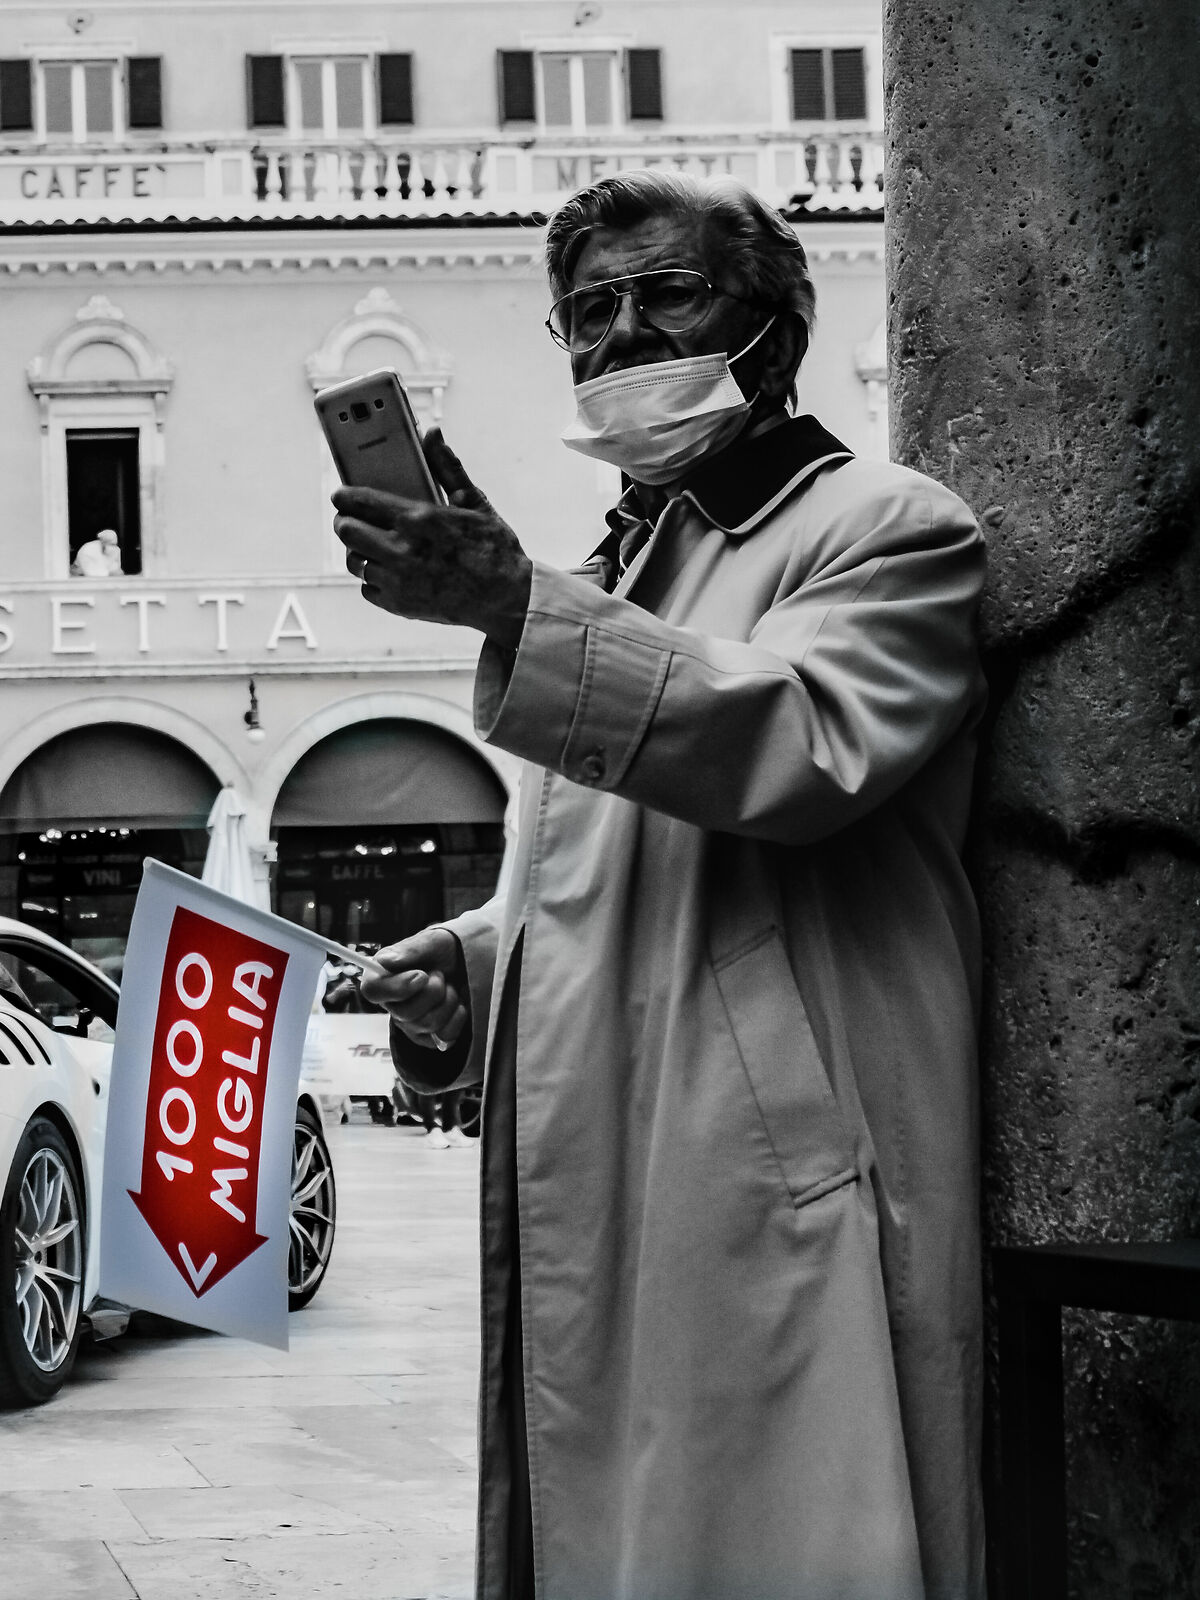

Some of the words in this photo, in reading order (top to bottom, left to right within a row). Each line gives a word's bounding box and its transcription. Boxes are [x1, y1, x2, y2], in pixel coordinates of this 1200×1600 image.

[82, 868, 122, 887] VINI
[155, 951, 214, 1181] 1000
[210, 960, 274, 1224] MIGLIA
